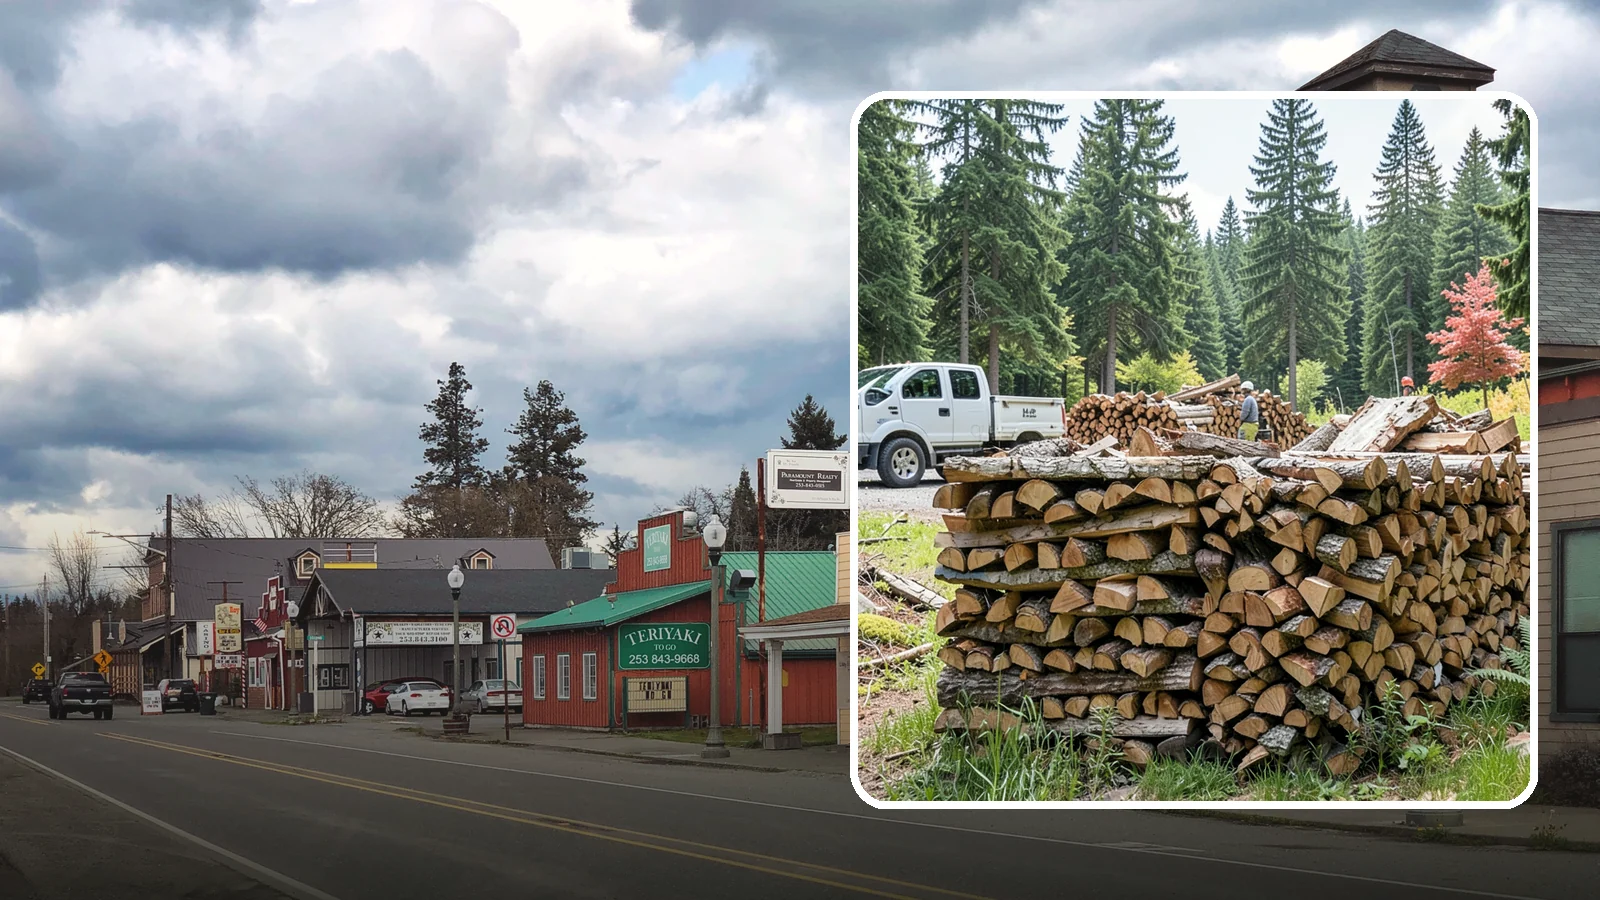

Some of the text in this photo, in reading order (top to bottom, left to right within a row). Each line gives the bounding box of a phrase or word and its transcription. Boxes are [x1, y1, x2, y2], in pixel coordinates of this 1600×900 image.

[646, 531, 668, 548] TERIYAKI
[624, 628, 702, 646] TERIYAKI
[629, 654, 700, 664] 253 843-9668
